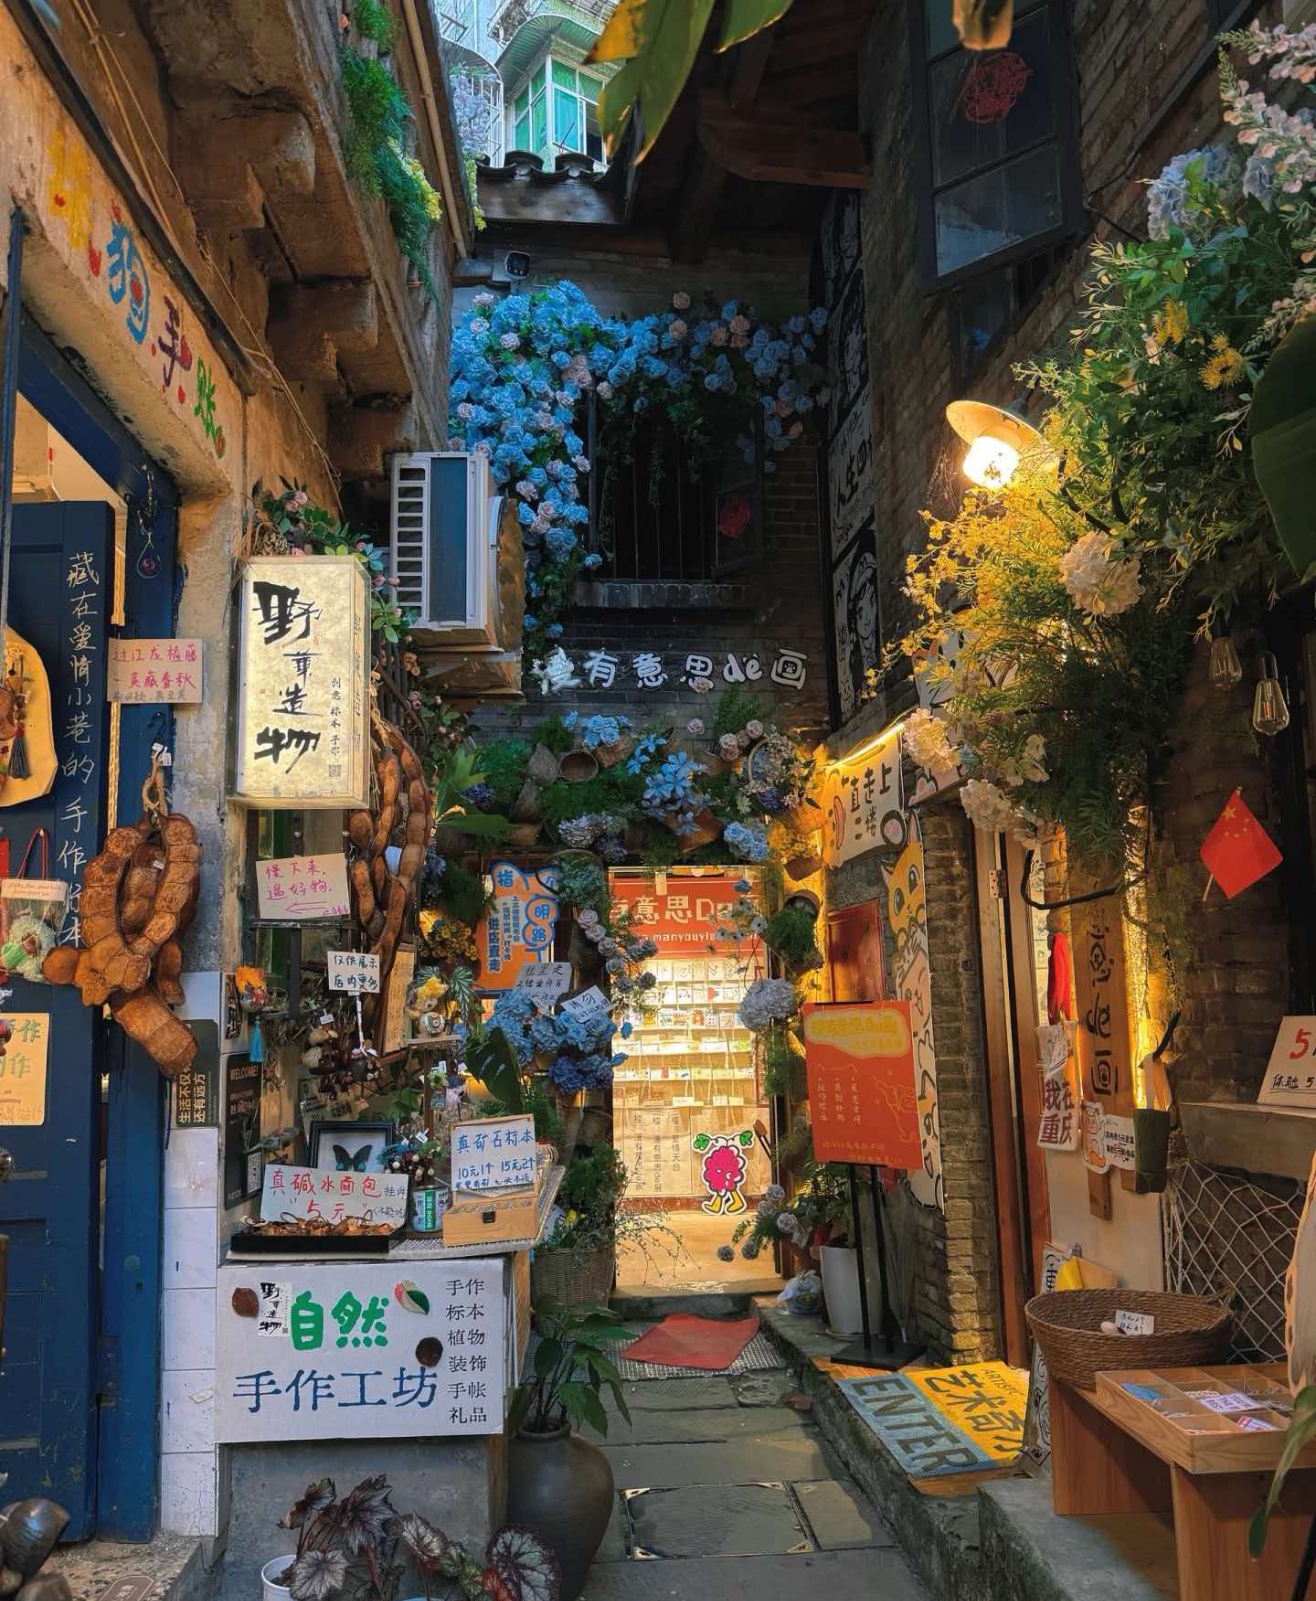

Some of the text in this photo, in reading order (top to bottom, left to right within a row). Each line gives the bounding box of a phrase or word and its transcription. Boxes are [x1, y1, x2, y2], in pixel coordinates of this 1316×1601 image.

[178, 1067, 191, 1124] 生活不仅
[193, 1073, 206, 1124] 还有远方
[456, 1128, 535, 1154] 真矿石标本
[446, 1278, 485, 1296] 手作
[290, 1291, 389, 1350] 自然
[446, 1303, 485, 1321] 标本
[448, 1328, 485, 1346] 植物
[448, 1354, 487, 1373] 装饰
[232, 1366, 438, 1413] 手作工坊
[447, 1380, 487, 1398] 手帐
[448, 1406, 488, 1424] 礼品
[850, 1376, 980, 1473] ENTER
